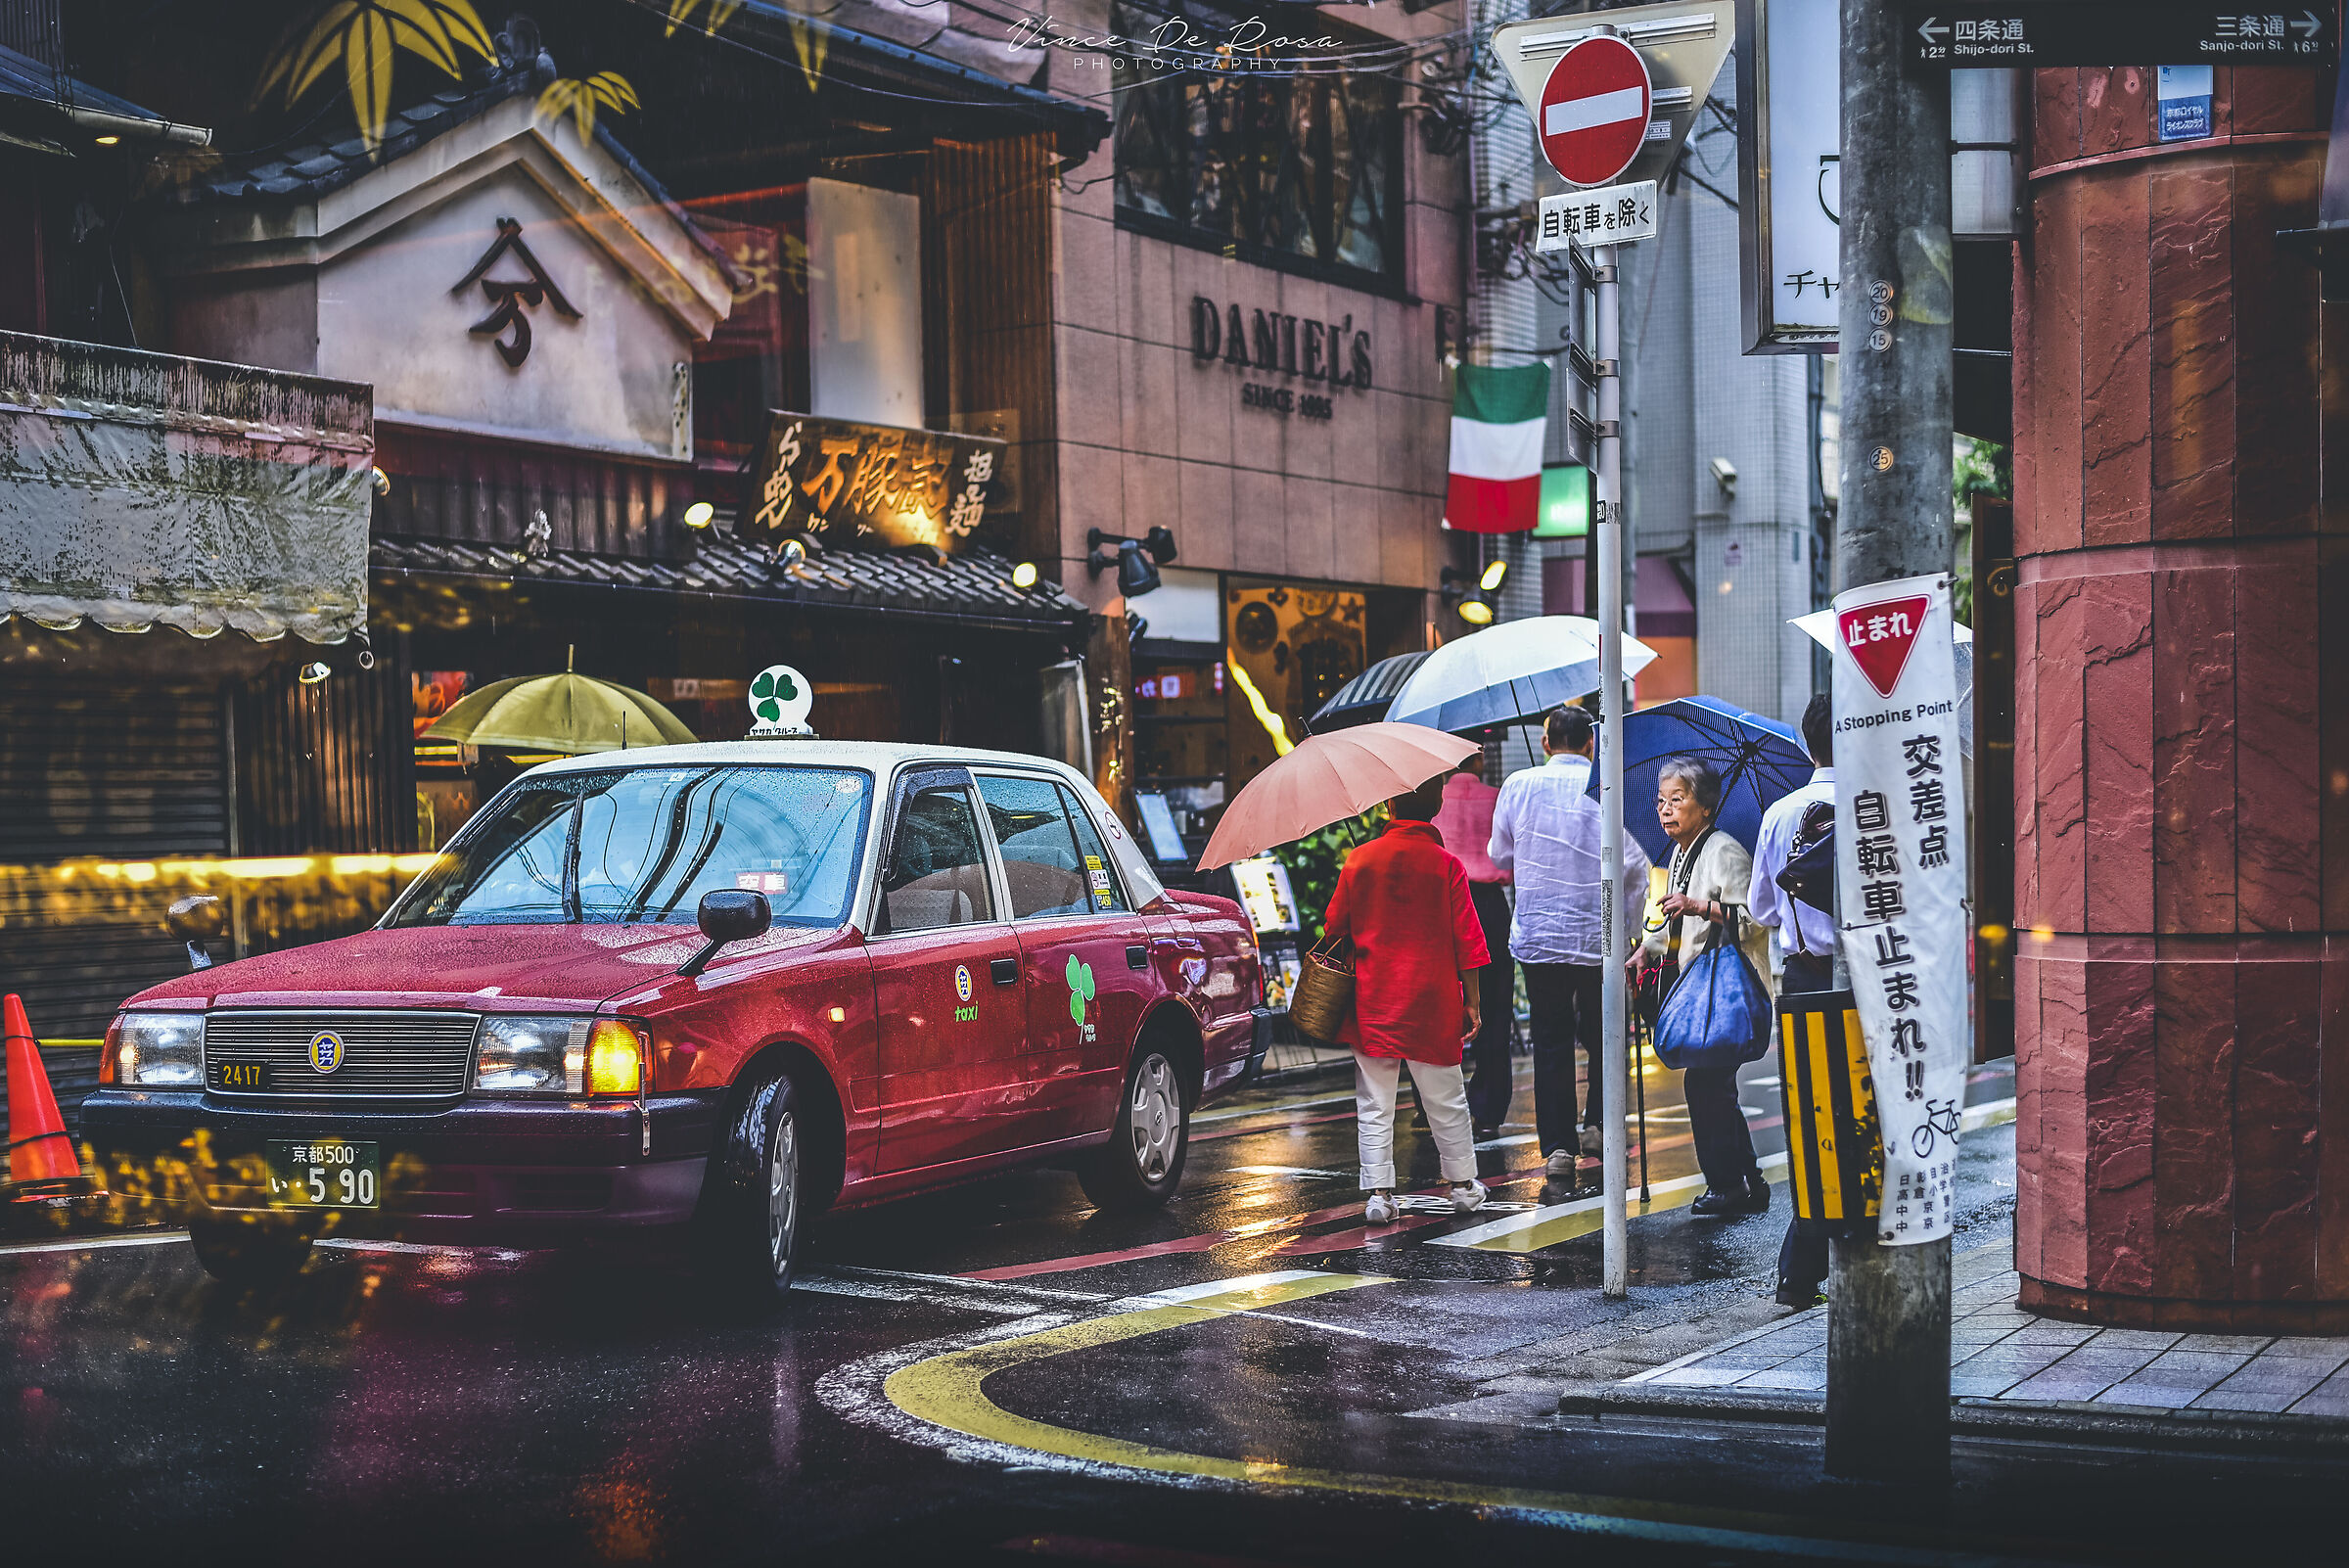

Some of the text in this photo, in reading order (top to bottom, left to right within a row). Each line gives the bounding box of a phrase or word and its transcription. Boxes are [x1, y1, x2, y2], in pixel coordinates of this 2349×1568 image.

[1956, 19, 2024, 41] 四条通
[2215, 15, 2284, 37] 三条通
[1954, 43, 2035, 56] Shijo-dori St.
[2199, 39, 2284, 53] Sanjo-dori St.
[1543, 197, 1650, 238] 自転車を除く
[1192, 296, 1373, 390] DANIEL'S
[1242, 383, 1295, 413] SINCE
[1848, 612, 1912, 647] 止まれ
[1834, 700, 1953, 734] A Stopping Point
[1902, 734, 1949, 869] 交差点
[954, 1000, 979, 1023] taxi
[318, 1040, 334, 1066] ヤサカ
[223, 1065, 261, 1085] 2417
